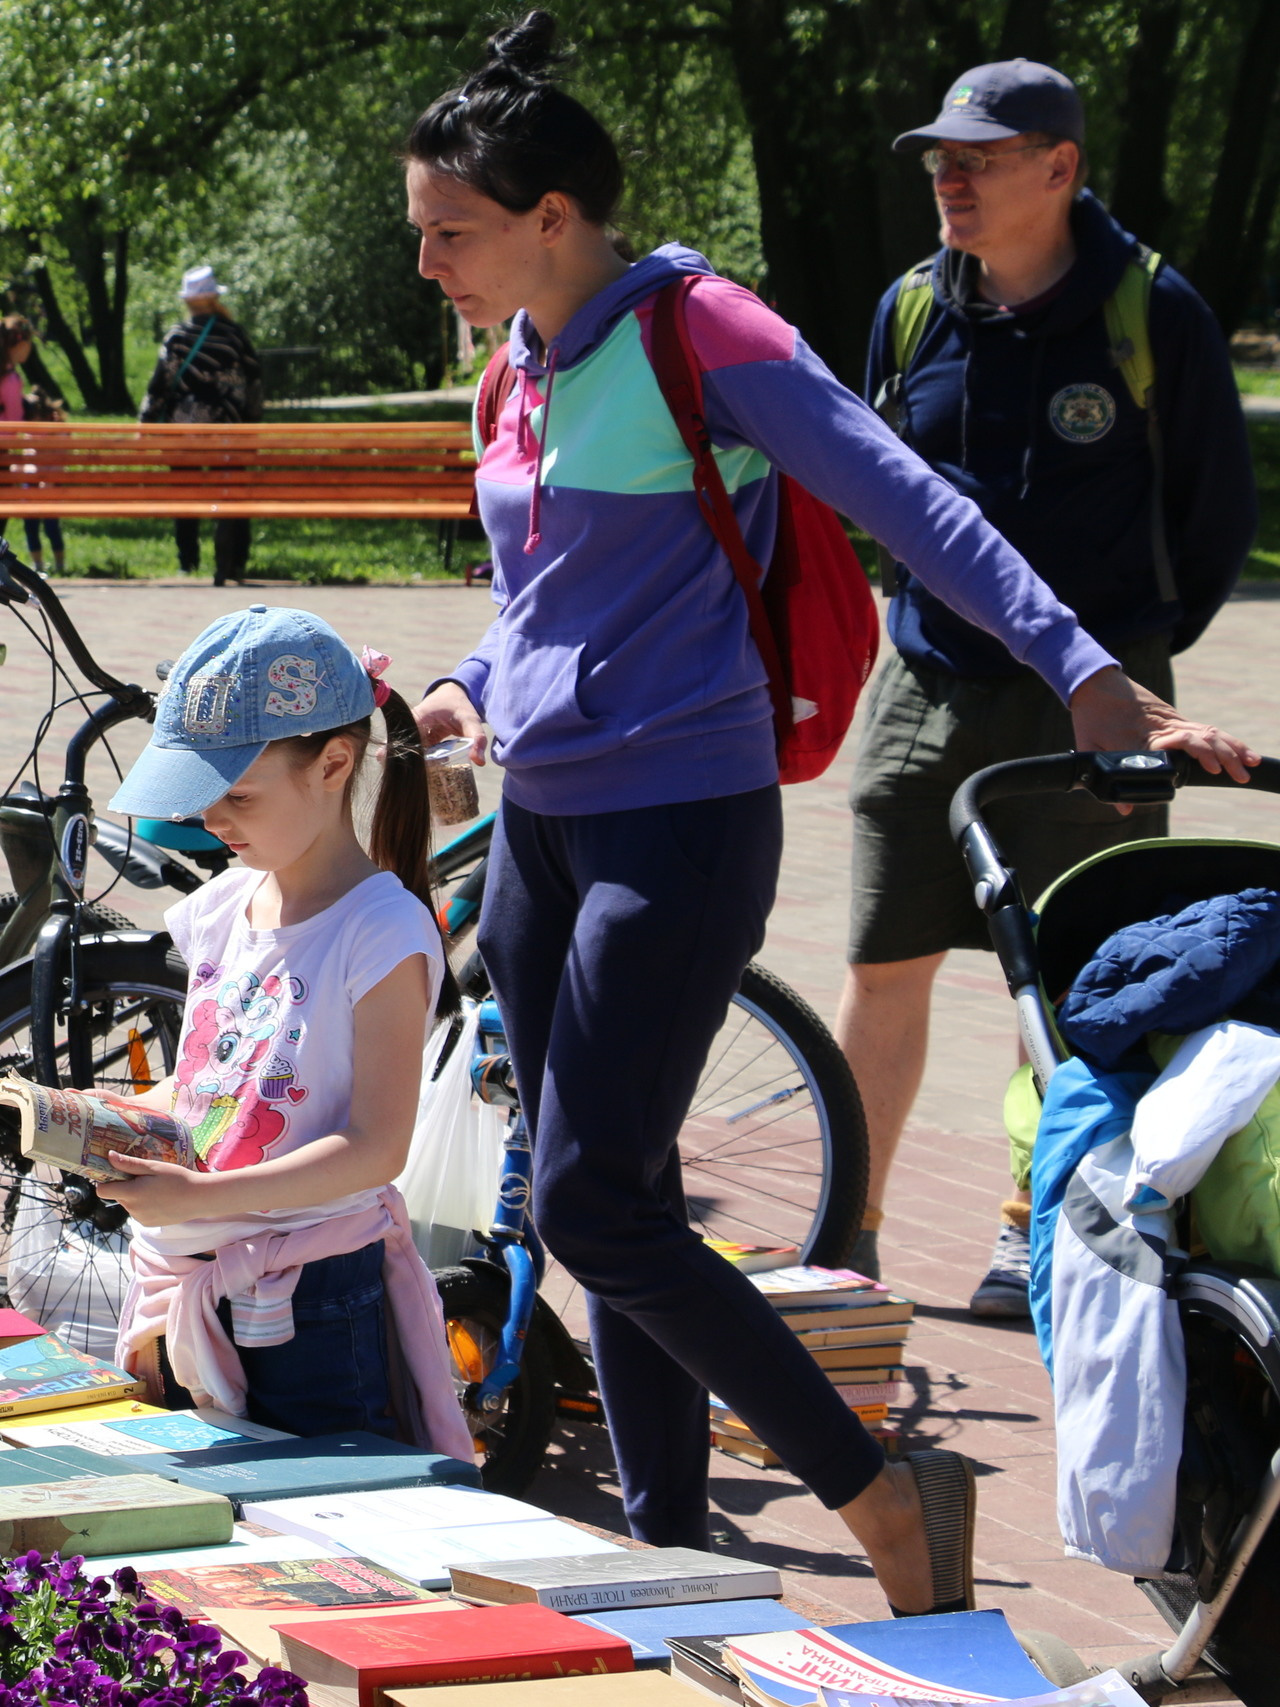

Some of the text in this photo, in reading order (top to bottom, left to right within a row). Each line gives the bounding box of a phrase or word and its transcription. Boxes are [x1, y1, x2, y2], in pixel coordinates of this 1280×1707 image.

[549, 1582, 719, 1607] Леонид Лиходеев ПОЛЕ БРАНИ
[801, 1645, 888, 1688] ПРАКТИКА
